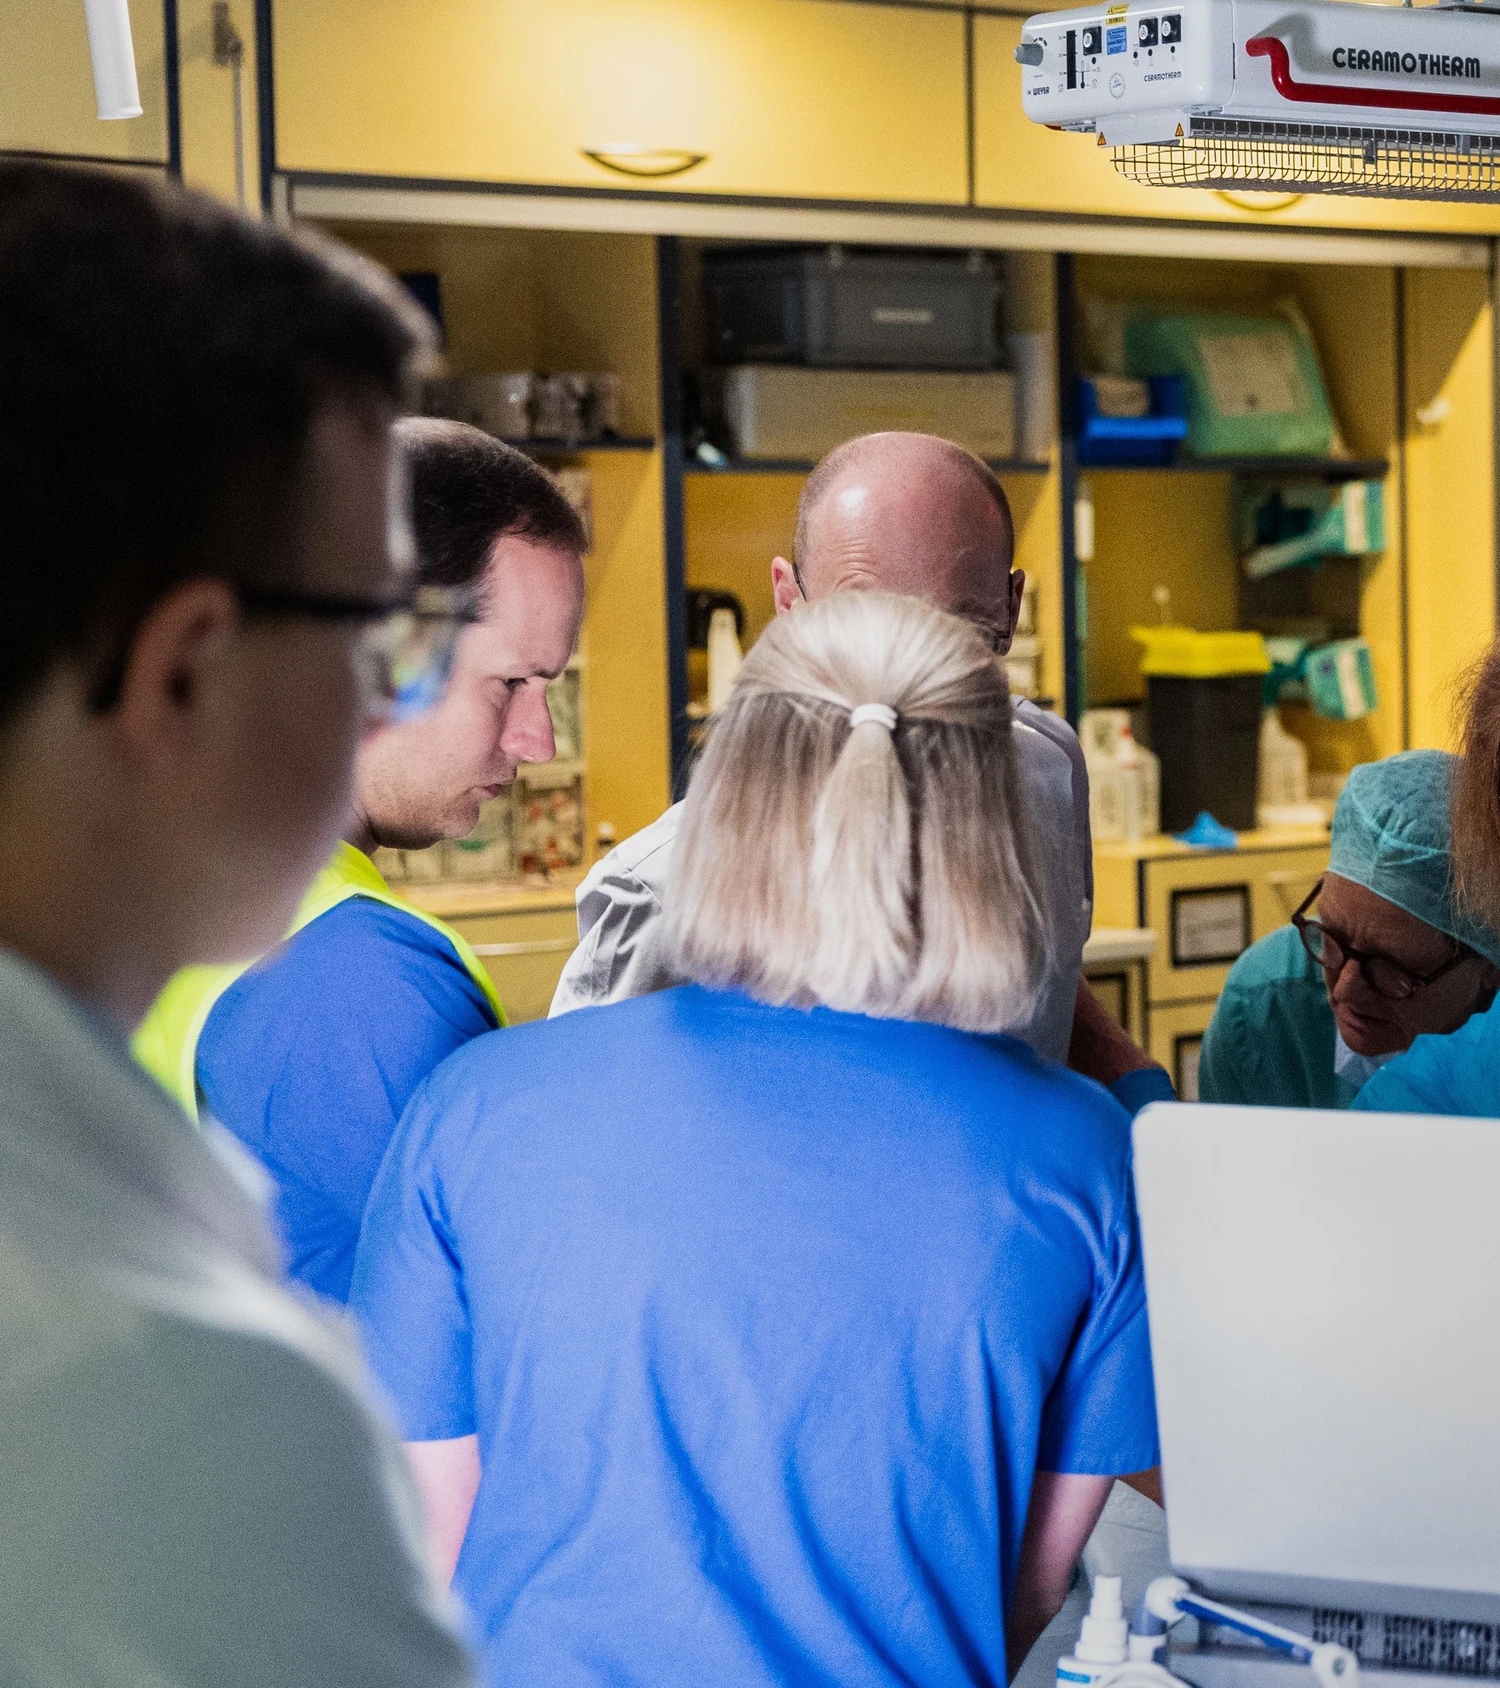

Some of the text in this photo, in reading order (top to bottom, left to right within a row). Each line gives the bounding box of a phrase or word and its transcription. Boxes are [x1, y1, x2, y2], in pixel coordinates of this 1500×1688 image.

[1332, 47, 1481, 78] CERAMOTHERM
[1143, 71, 1182, 83] CERAMOTHERM
[1032, 86, 1050, 96] WEYER
